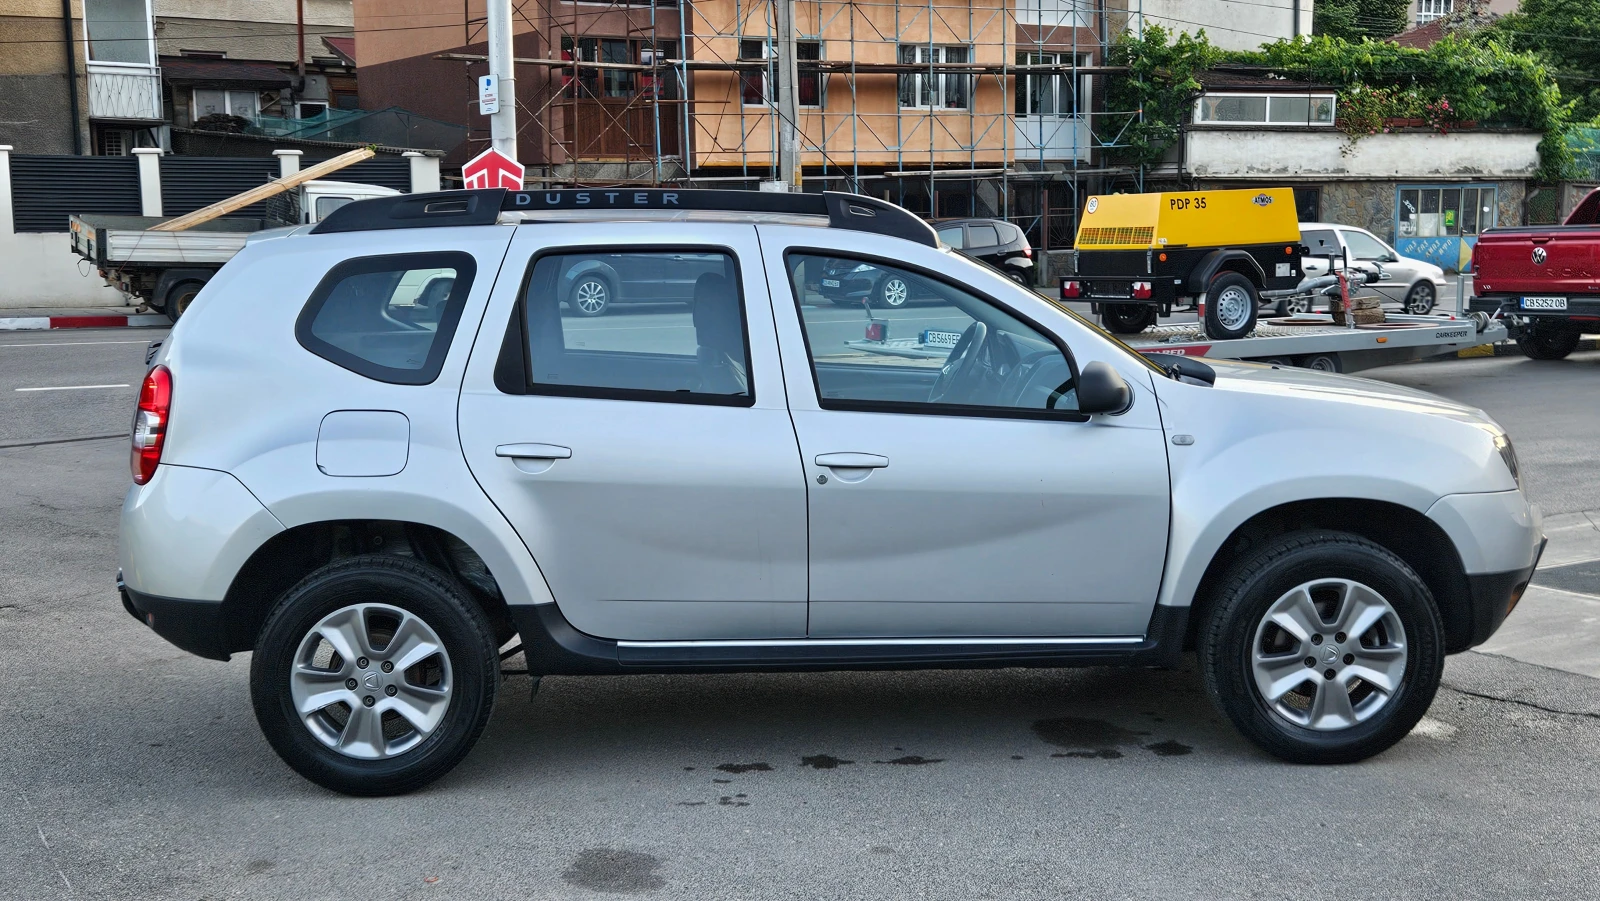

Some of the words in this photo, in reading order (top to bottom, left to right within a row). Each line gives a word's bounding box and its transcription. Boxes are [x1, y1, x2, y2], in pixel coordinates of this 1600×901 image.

[516, 192, 679, 205] DUSTER
[1170, 198, 1190, 210] PDP
[1194, 197, 1206, 209] 35
[1253, 196, 1272, 204] ATMOS
